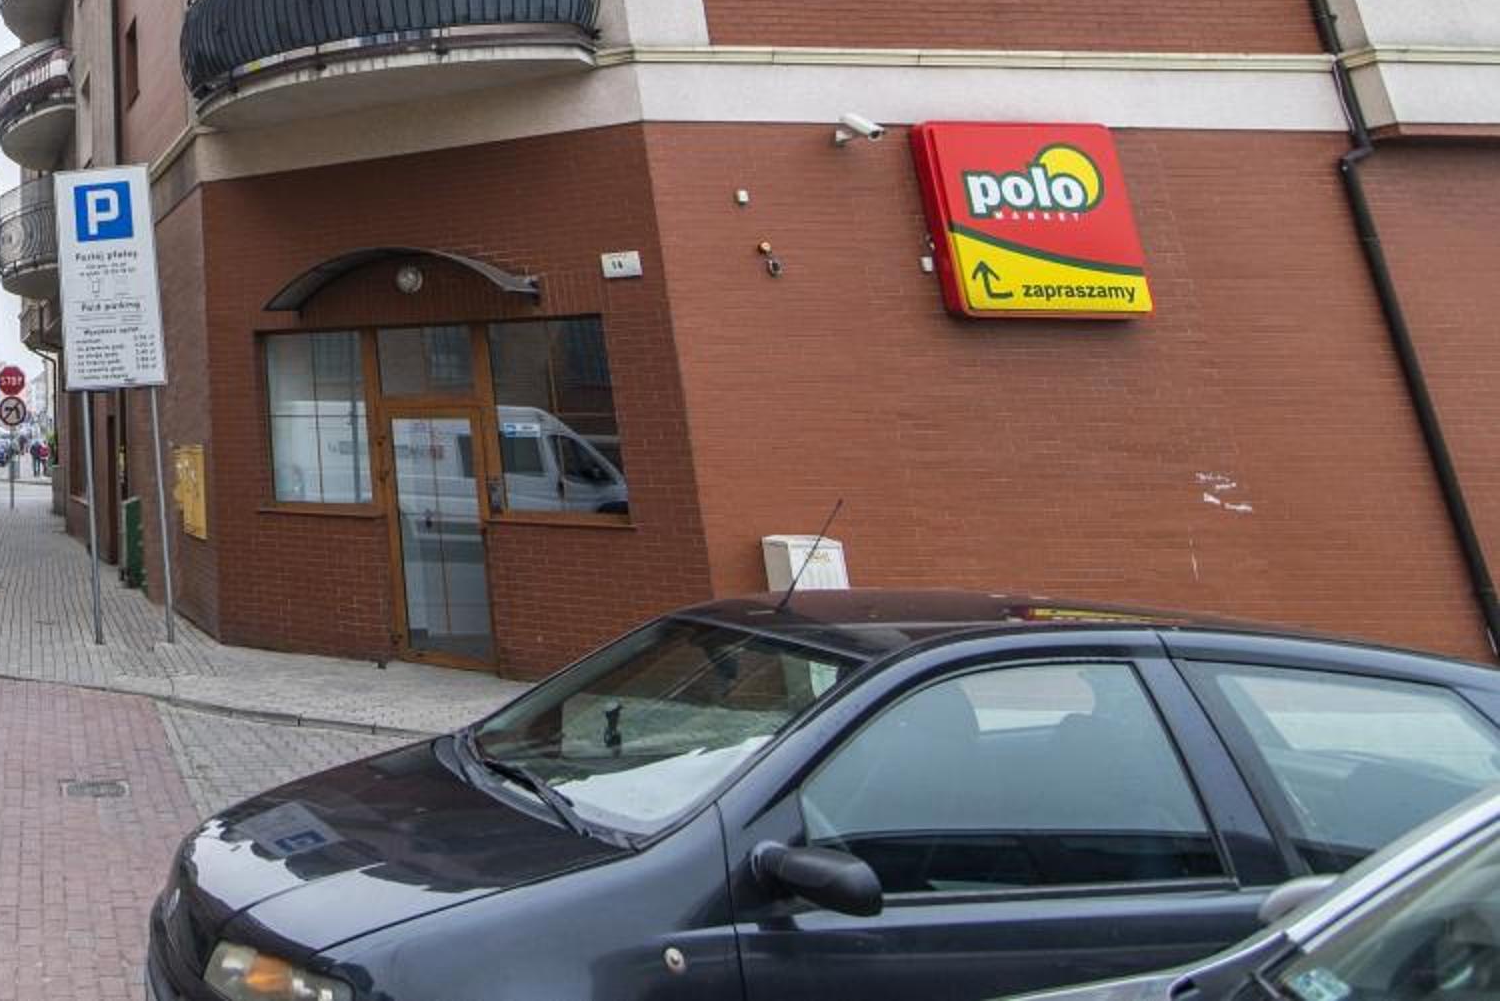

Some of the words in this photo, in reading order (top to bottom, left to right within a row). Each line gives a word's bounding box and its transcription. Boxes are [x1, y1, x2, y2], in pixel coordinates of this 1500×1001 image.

[965, 164, 1086, 216] polo
[86, 188, 119, 236] P
[994, 211, 1081, 222] MARKET
[1022, 283, 1136, 303] zapraszamy
[1, 375, 23, 386] STOP
